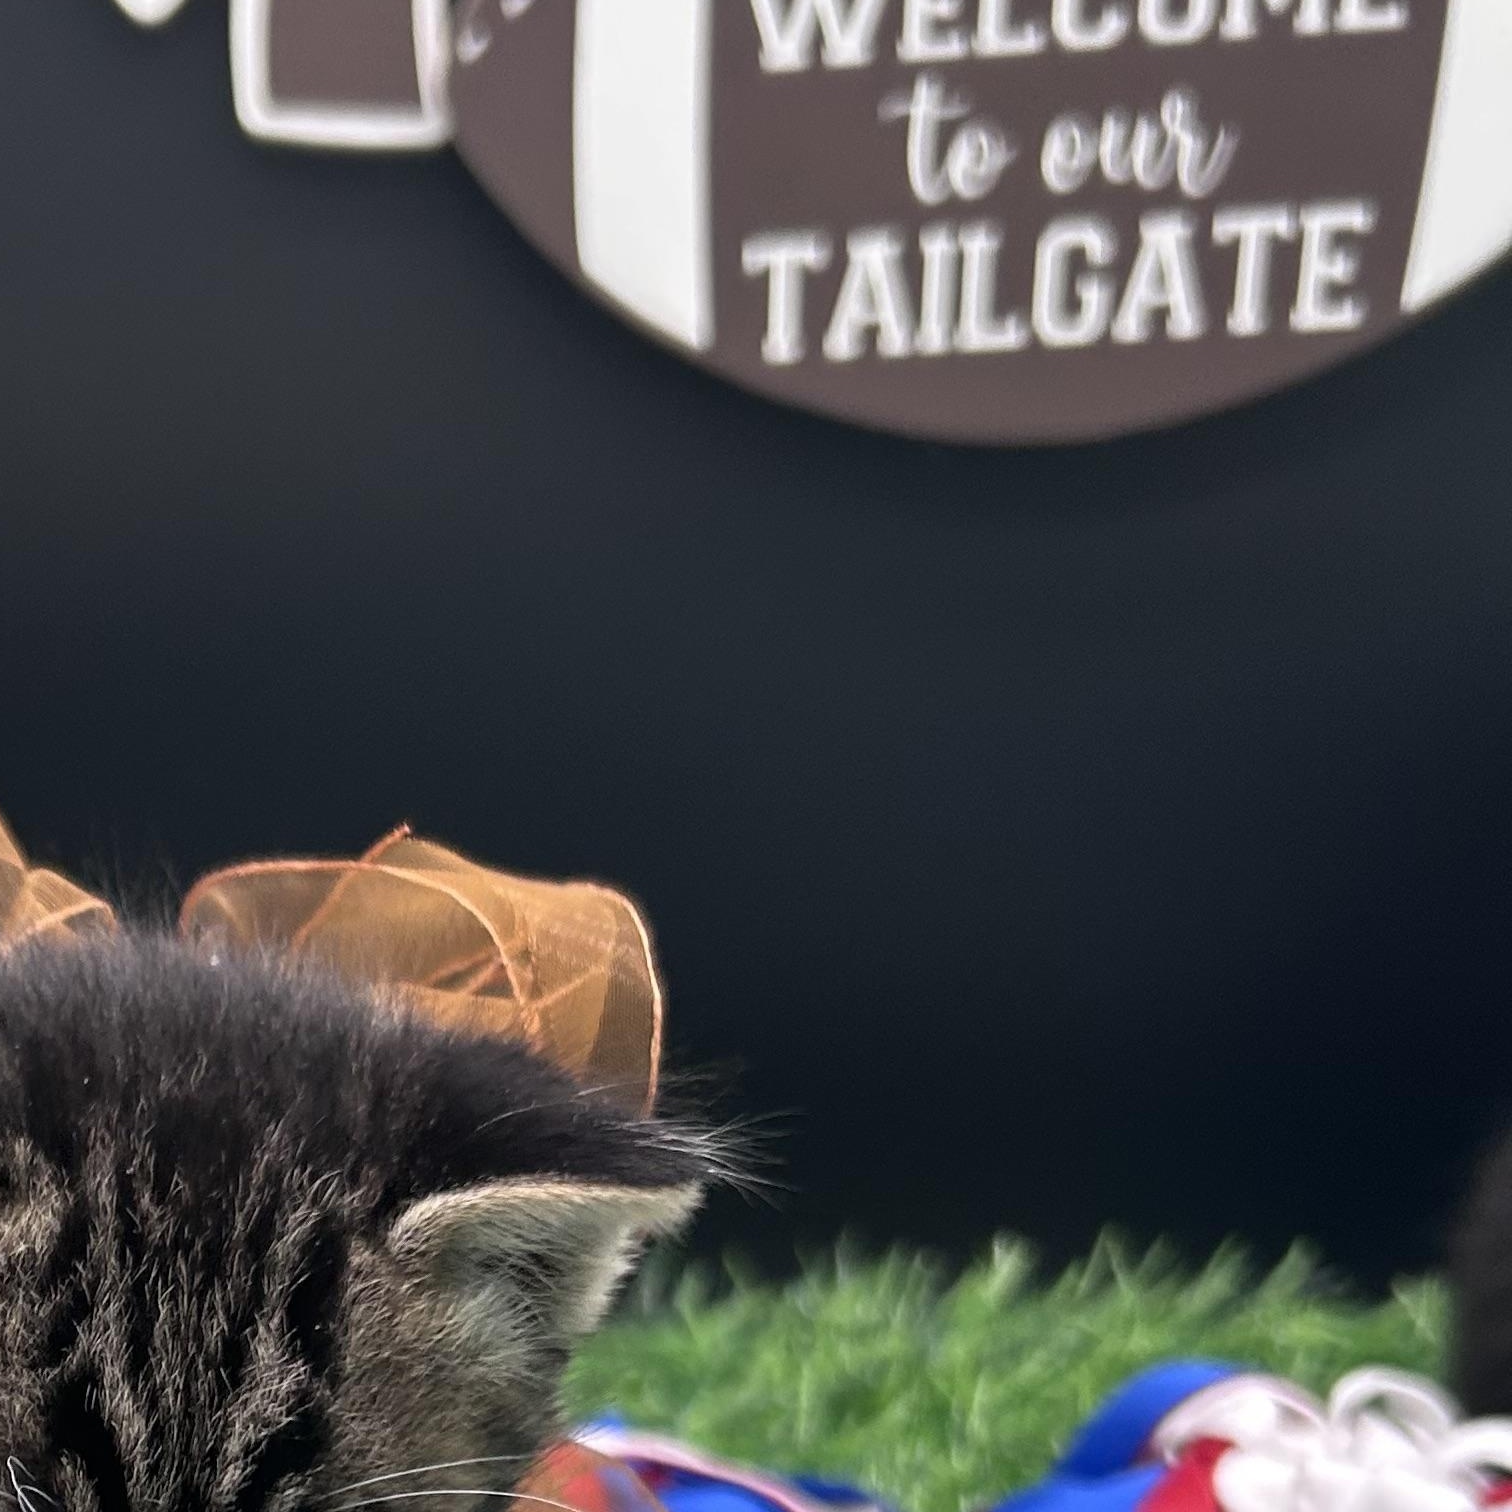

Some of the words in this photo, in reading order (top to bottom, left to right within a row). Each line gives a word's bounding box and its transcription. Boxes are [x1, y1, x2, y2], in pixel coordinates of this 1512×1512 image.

[750, 0, 1410, 73] WELCO
[878, 70, 1018, 206] to
[1039, 88, 1241, 200] our
[740, 202, 1376, 366] TAILGATE
